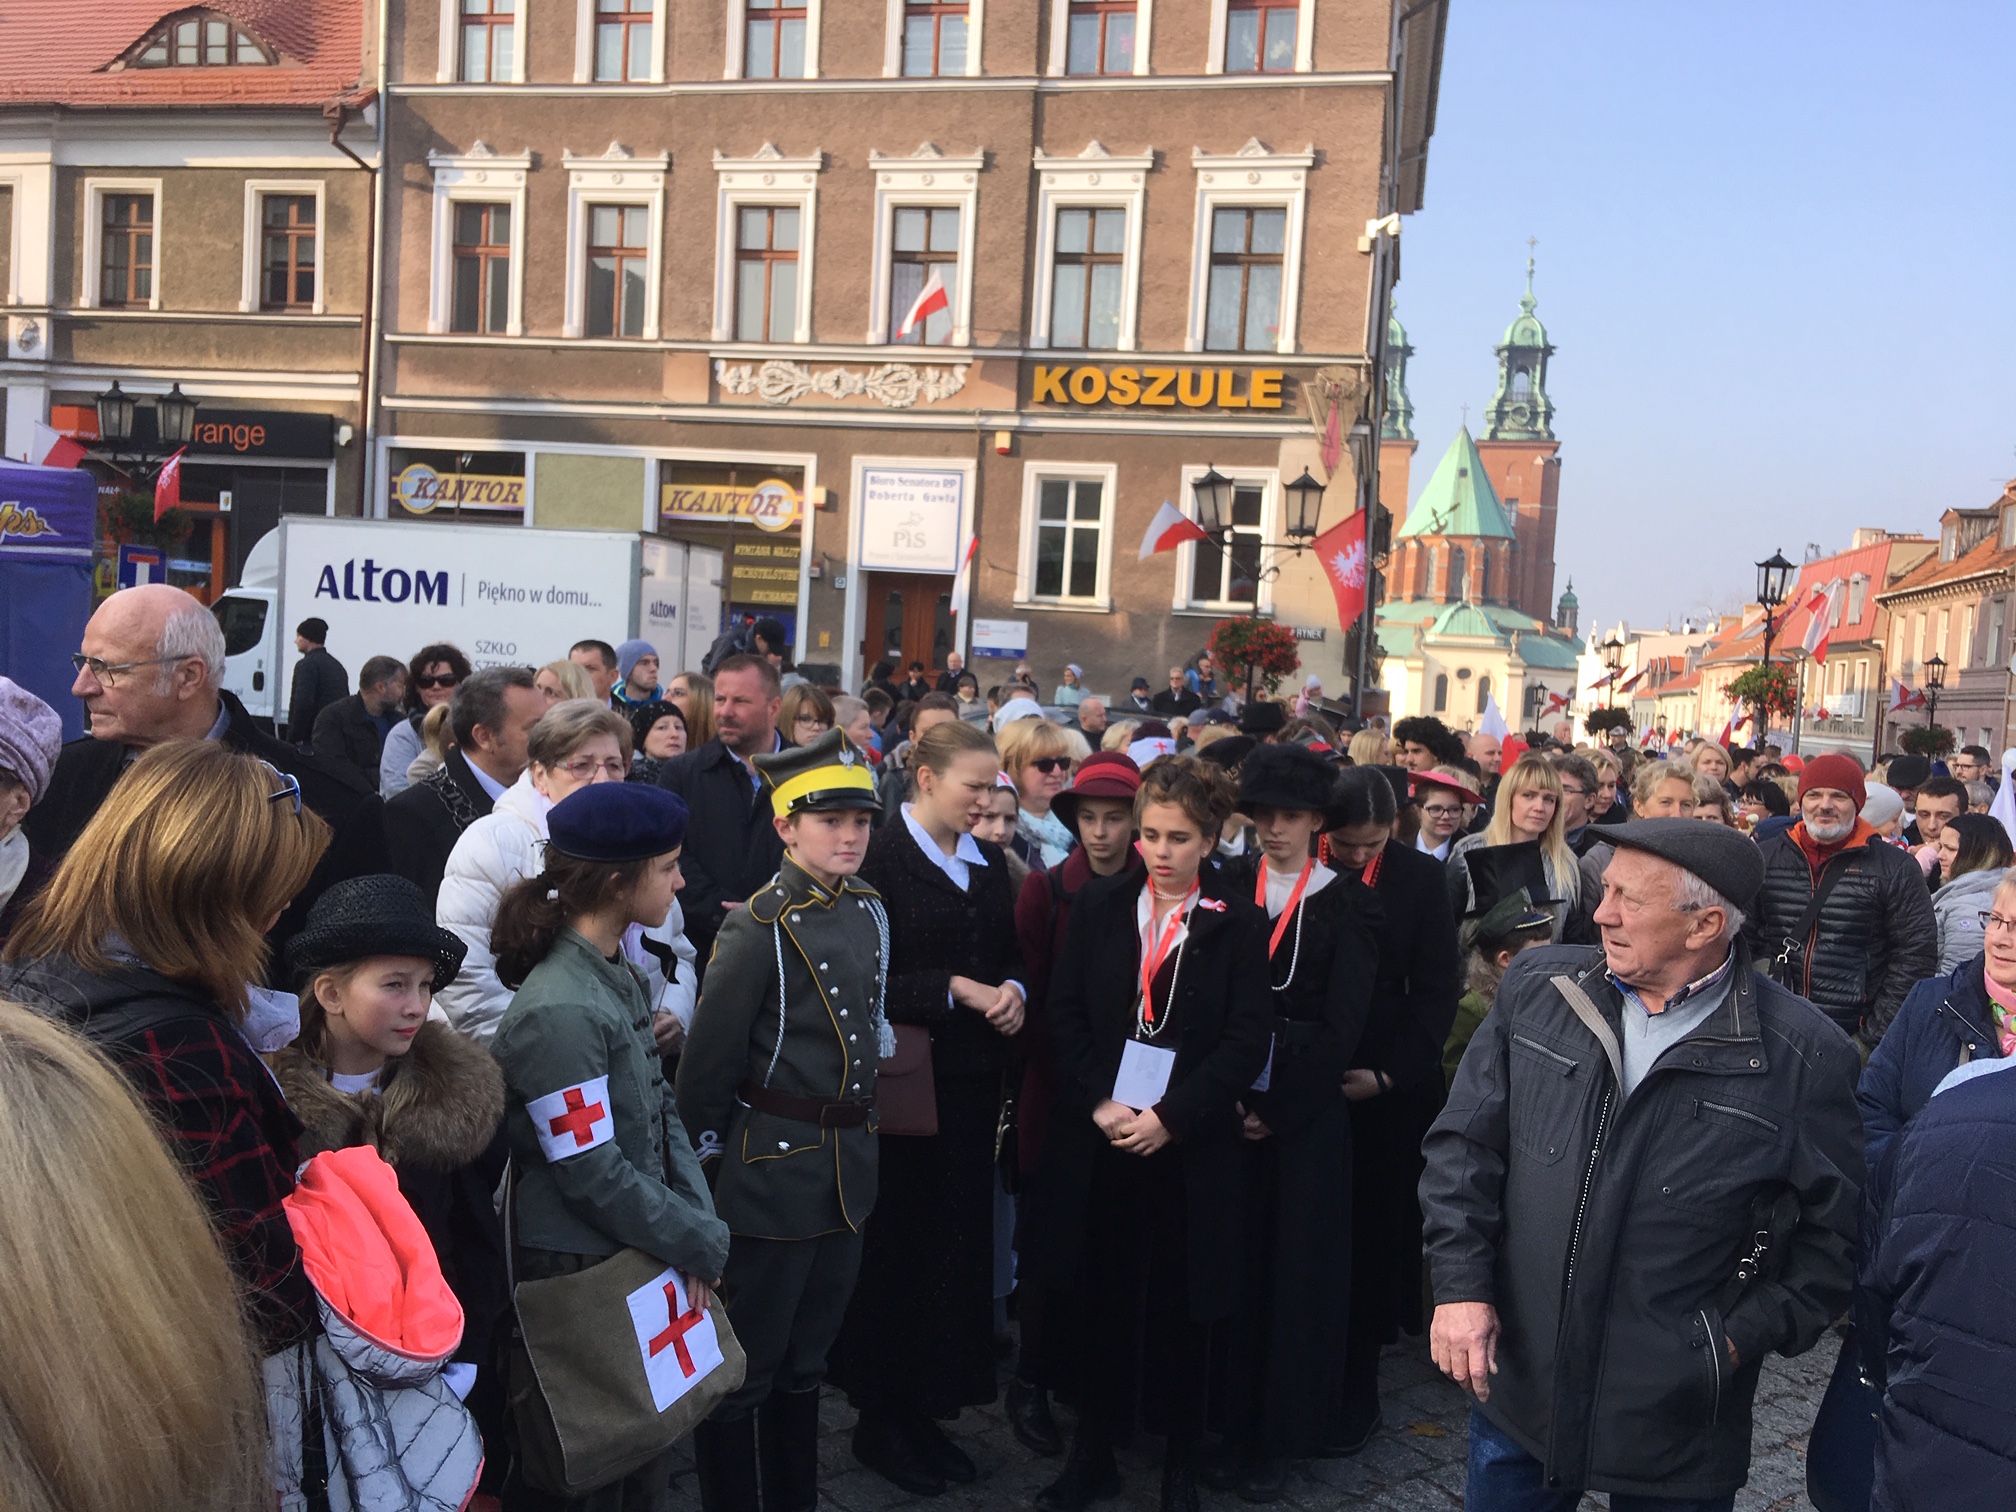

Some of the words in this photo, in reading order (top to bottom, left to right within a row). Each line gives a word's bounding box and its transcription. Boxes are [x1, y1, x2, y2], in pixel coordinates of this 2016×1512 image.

[1033, 365, 1284, 409] KOSZULE
[194, 424, 266, 451] range
[410, 477, 523, 504] KANTOR
[870, 475, 896, 487] Biuro
[898, 476, 941, 489] Senatora
[665, 489, 783, 517] KANTOR
[868, 490, 915, 502] Roberta
[892, 530, 926, 549] PiS
[478, 580, 526, 606] Piękno
[529, 588, 543, 604] w
[546, 584, 602, 607] domu...
[1296, 627, 1322, 640] RYNEK
[475, 640, 517, 656] SZKŁO
